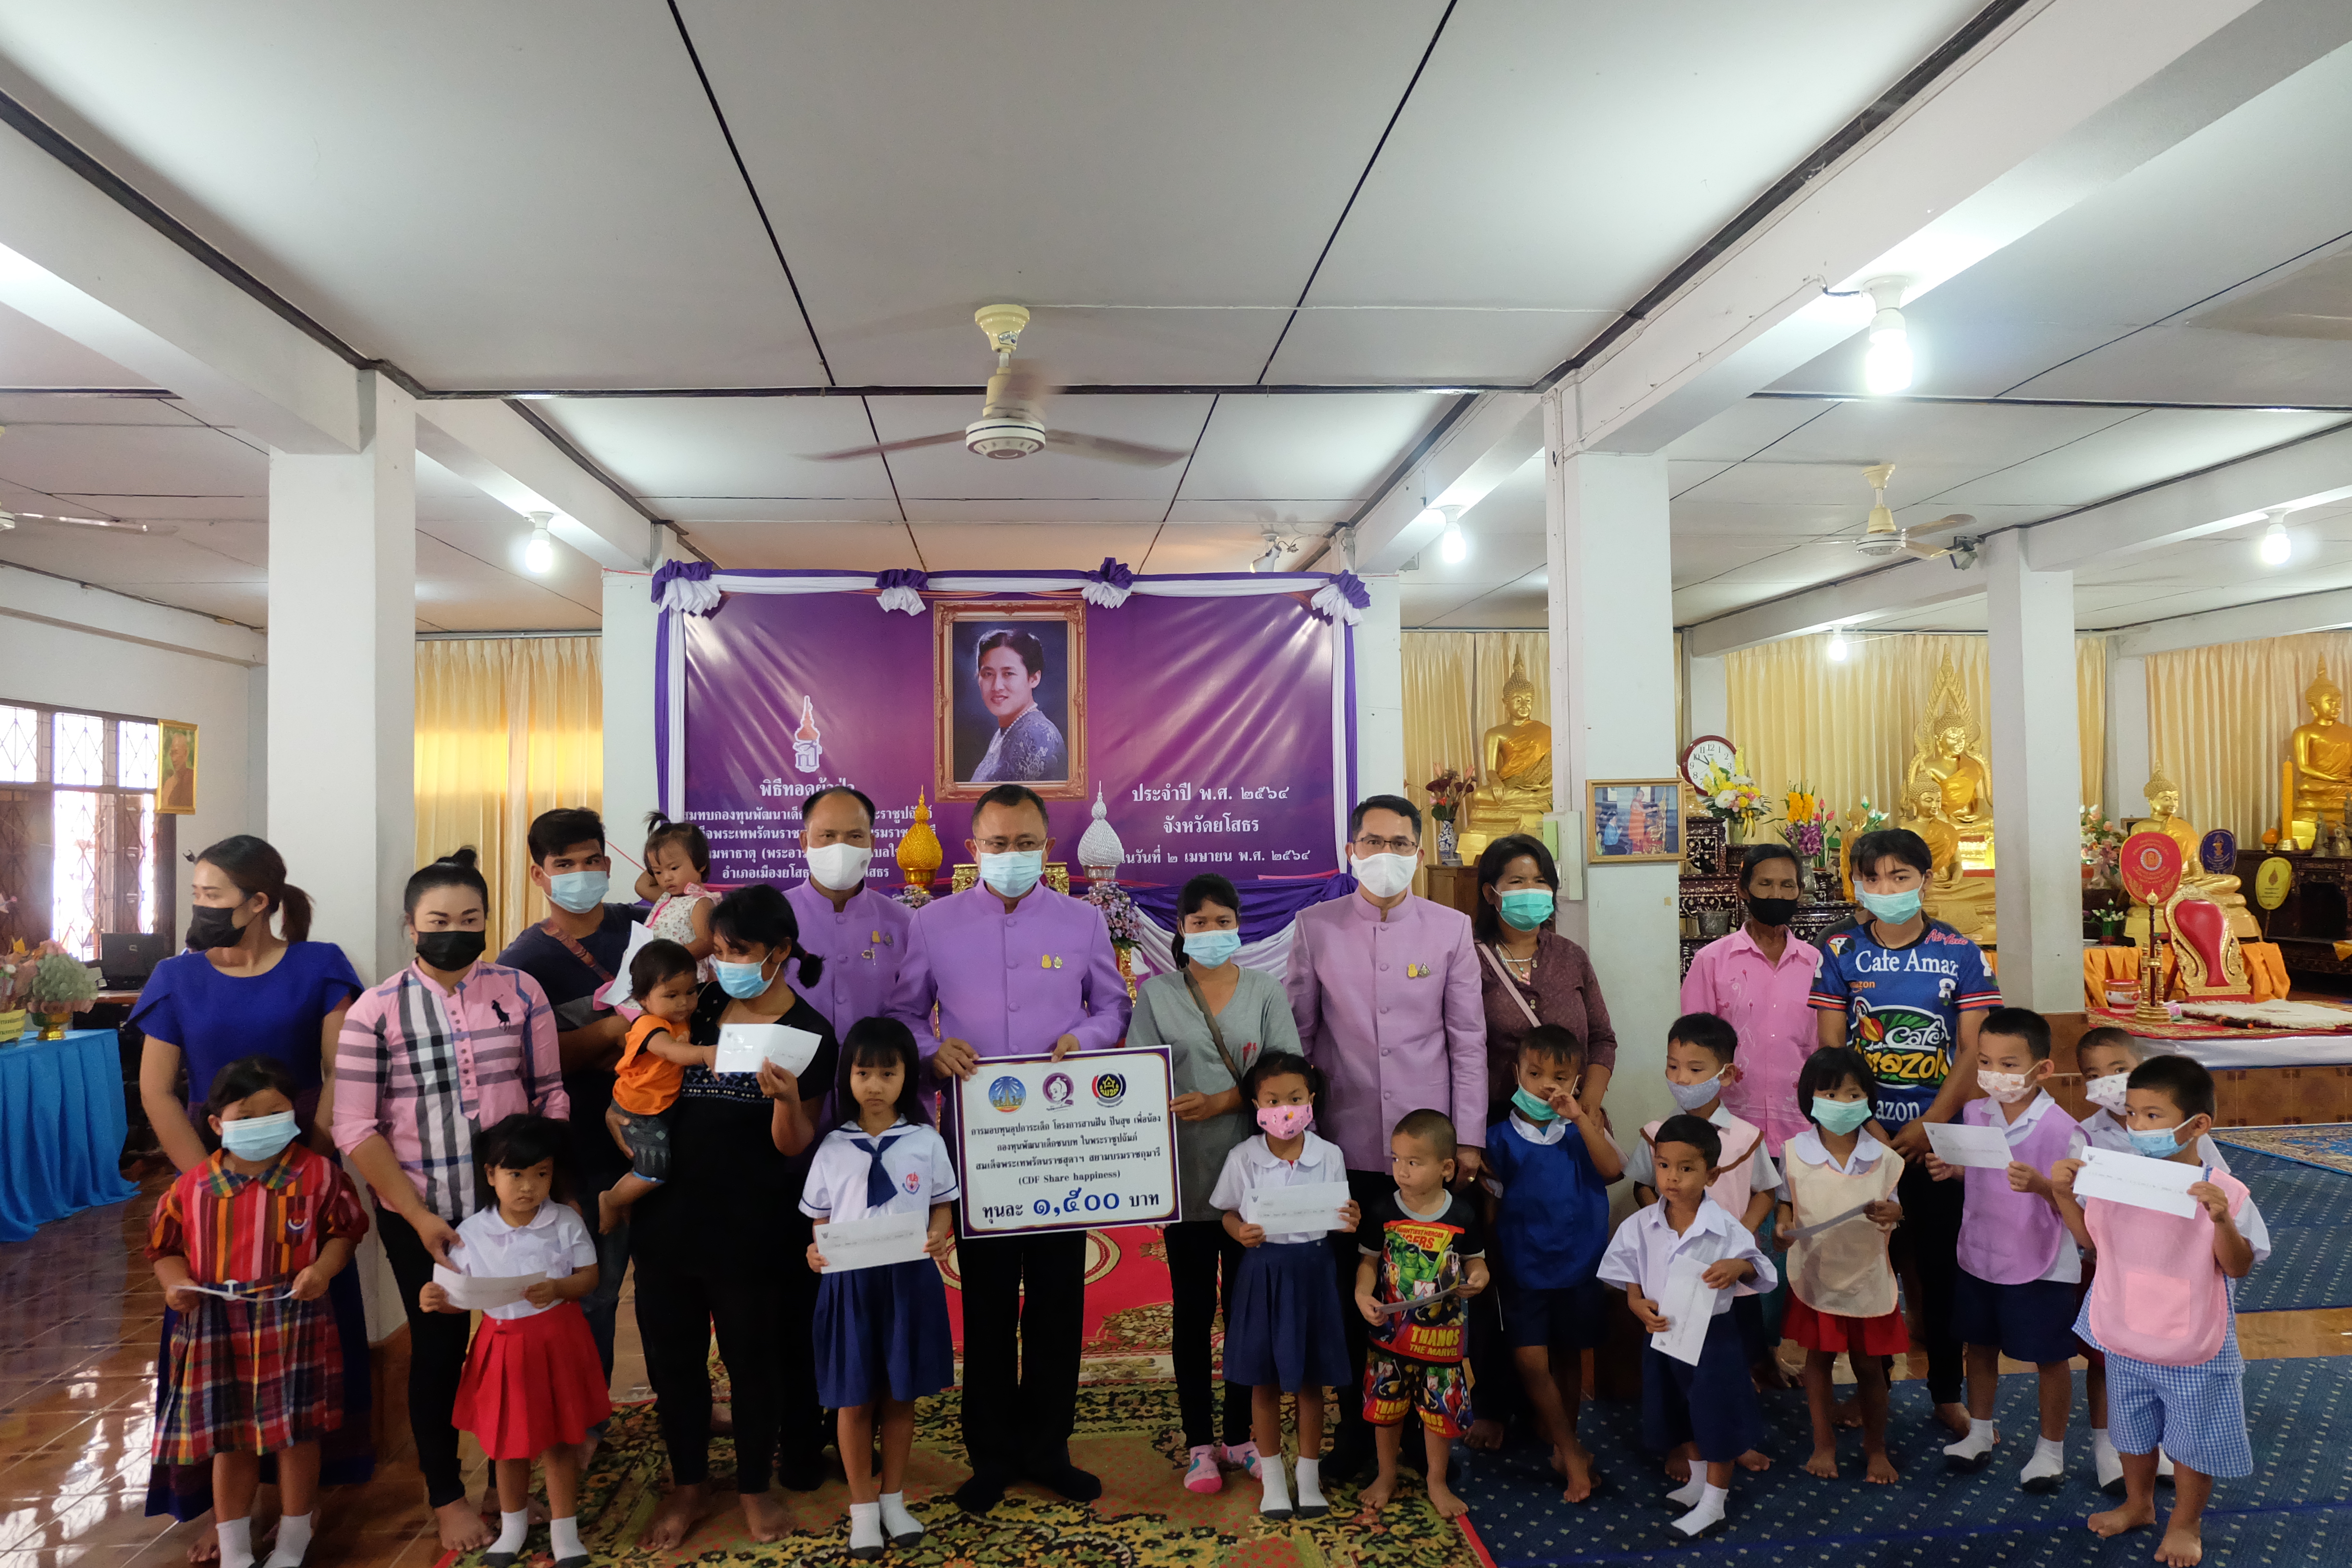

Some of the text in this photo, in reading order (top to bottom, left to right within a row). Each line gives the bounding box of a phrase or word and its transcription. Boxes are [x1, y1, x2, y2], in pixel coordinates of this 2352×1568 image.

[1132, 782, 1290, 802] ประจำปี พ.ศ. ๒๕๖๔
[1163, 812, 1259, 833] จังหวัดยโสธร
[1167, 853, 1178, 863] ๒
[1184, 851, 1233, 862] เมษายน
[1238, 850, 1265, 862] พ.ศ.
[1271, 849, 1311, 861] ๒๕๖๔
[1855, 948, 1959, 978] Cafe Amaz
[971, 1111, 1161, 1137] การมอบทุนอุปการะเด็ก โครงการสานฝัน ปันสุข เพื่อน้อง
[997, 1138, 1078, 1153] กองทุนพัฒนาเด็กชนบท
[1089, 1146, 1161, 1162] สยามบรมราชกุมารี
[1018, 1169, 1121, 1186] (CDF Share happiness)
[982, 1187, 1160, 1224] ทุนละ ๑,๕๐๐ บาท
[1413, 1280, 1436, 1298] VS
[1410, 1325, 1460, 1347] THANOS
[1410, 1344, 1458, 1357] THE MARVEL
